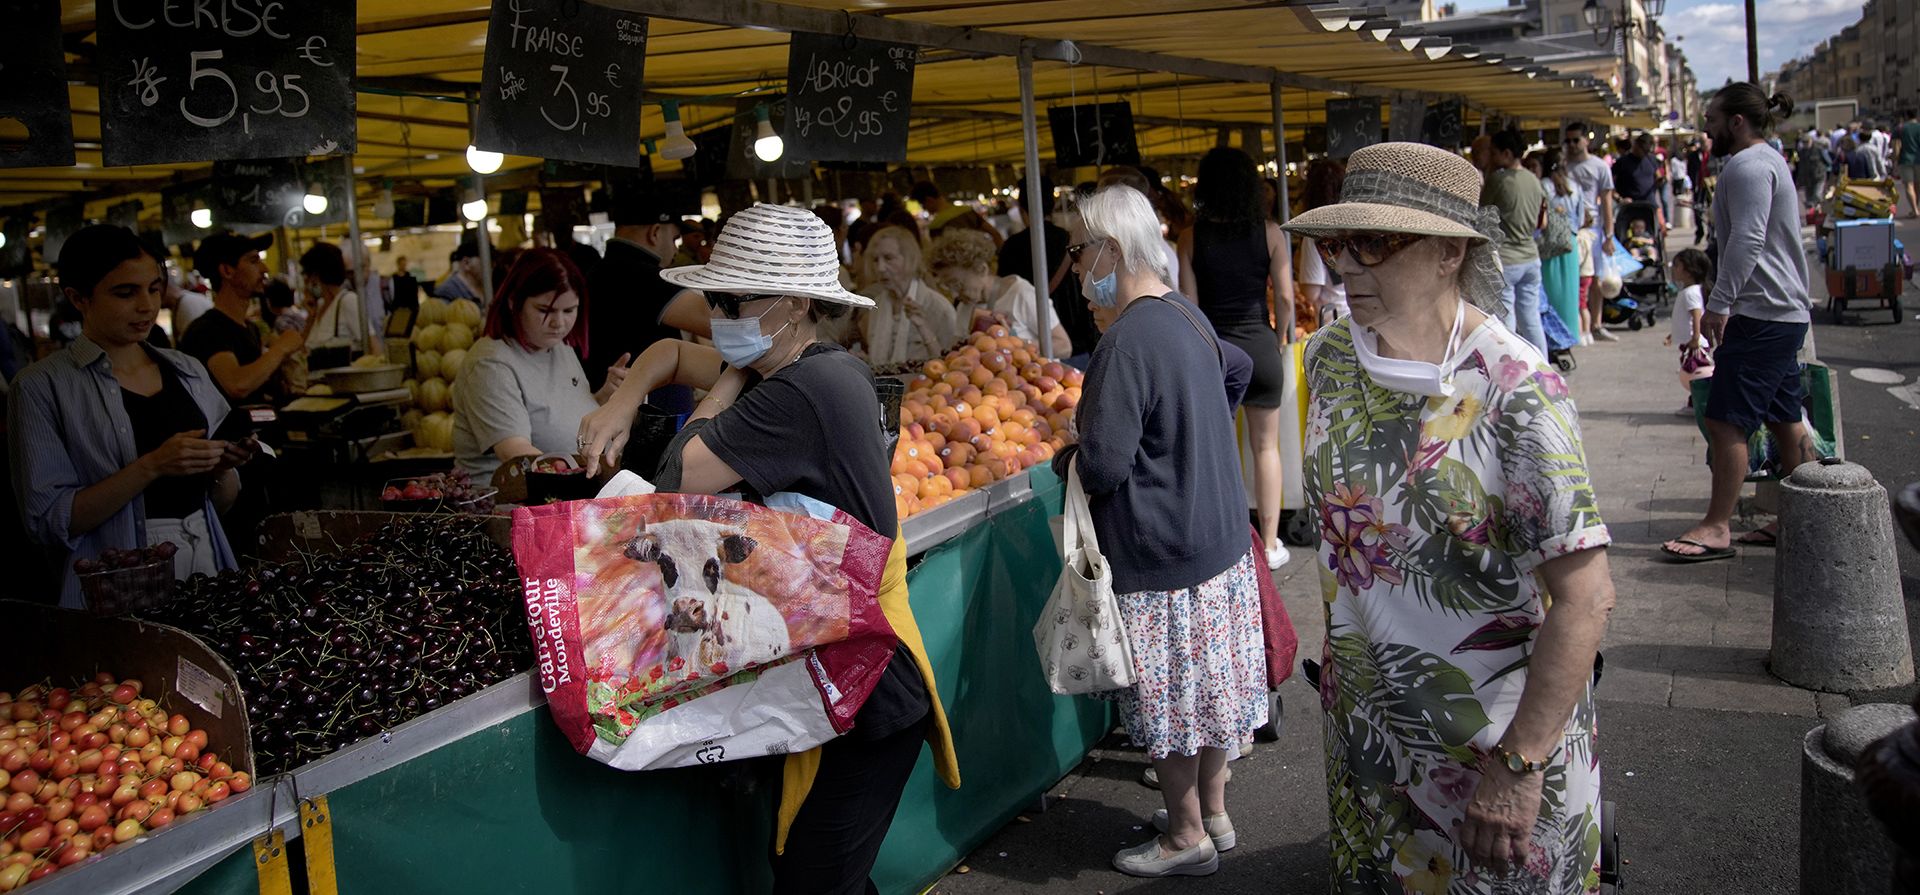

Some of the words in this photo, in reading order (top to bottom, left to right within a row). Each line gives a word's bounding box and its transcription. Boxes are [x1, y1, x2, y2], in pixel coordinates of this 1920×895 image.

[508, 0, 584, 58] FRAISE
[180, 49, 310, 134] 5,95
[540, 64, 611, 136] 3,95
[525, 576, 557, 694] Carrefour
[544, 578, 572, 685] Mondeville
